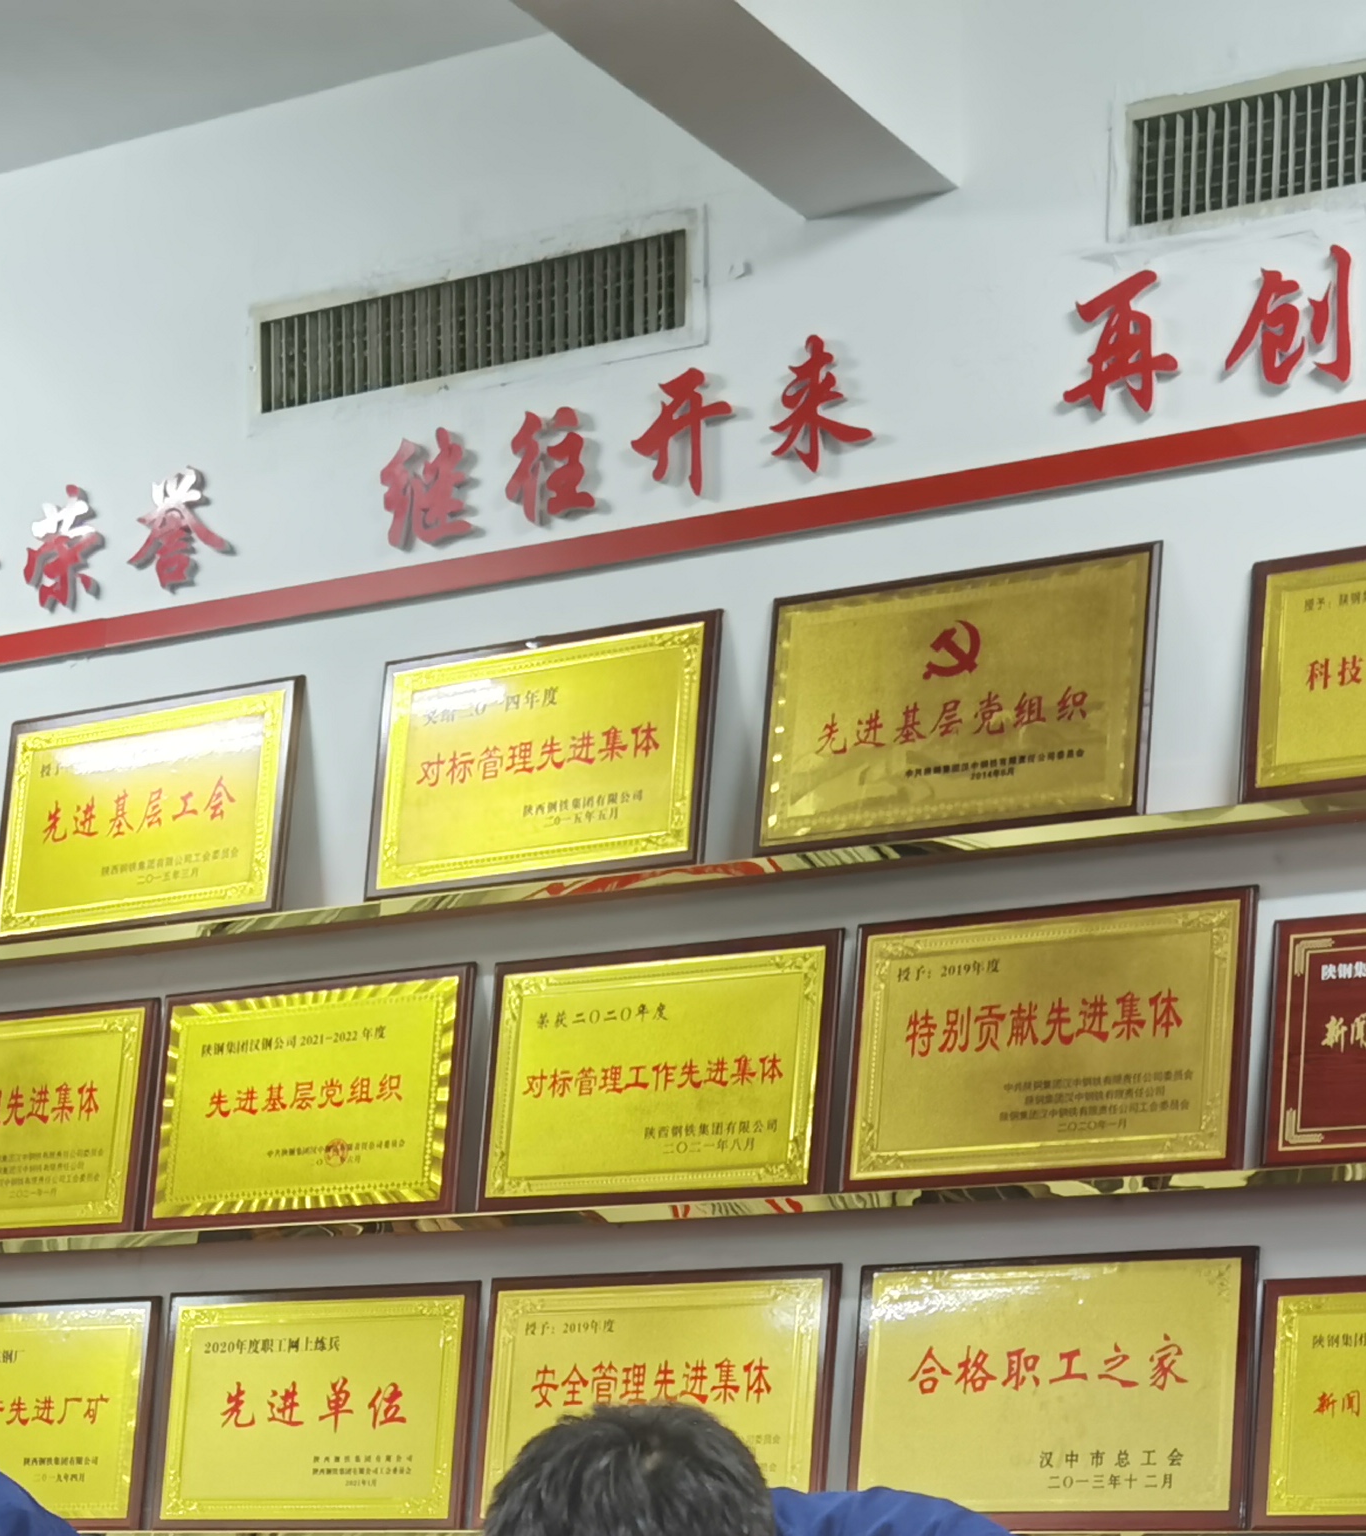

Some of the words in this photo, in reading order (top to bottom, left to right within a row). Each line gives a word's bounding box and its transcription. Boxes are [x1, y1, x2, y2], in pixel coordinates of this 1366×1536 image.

[380, 334, 873, 549] 继往开来
[815, 685, 1089, 756] 先进基层党组织
[416, 722, 661, 787] 对标管理先进集体
[42, 775, 236, 844] 先进基层工会
[362, 1025, 387, 1041] 年度
[905, 988, 1184, 1059] 特别贡献先进集体
[205, 1073, 403, 1119] 先进基层党组织
[523, 1053, 784, 1099] 对标管理工作先进集体
[644, 1119, 778, 1140] 陕西钢铁集团有限公司
[204, 1336, 340, 1355] 2020年度职工网上练兵
[907, 1333, 1189, 1396] 合格职工之家
[220, 1375, 407, 1434] 先进单位
[531, 1356, 773, 1409] 安全管理先进集体
[1039, 1448, 1185, 1469] 汉中市总工会
